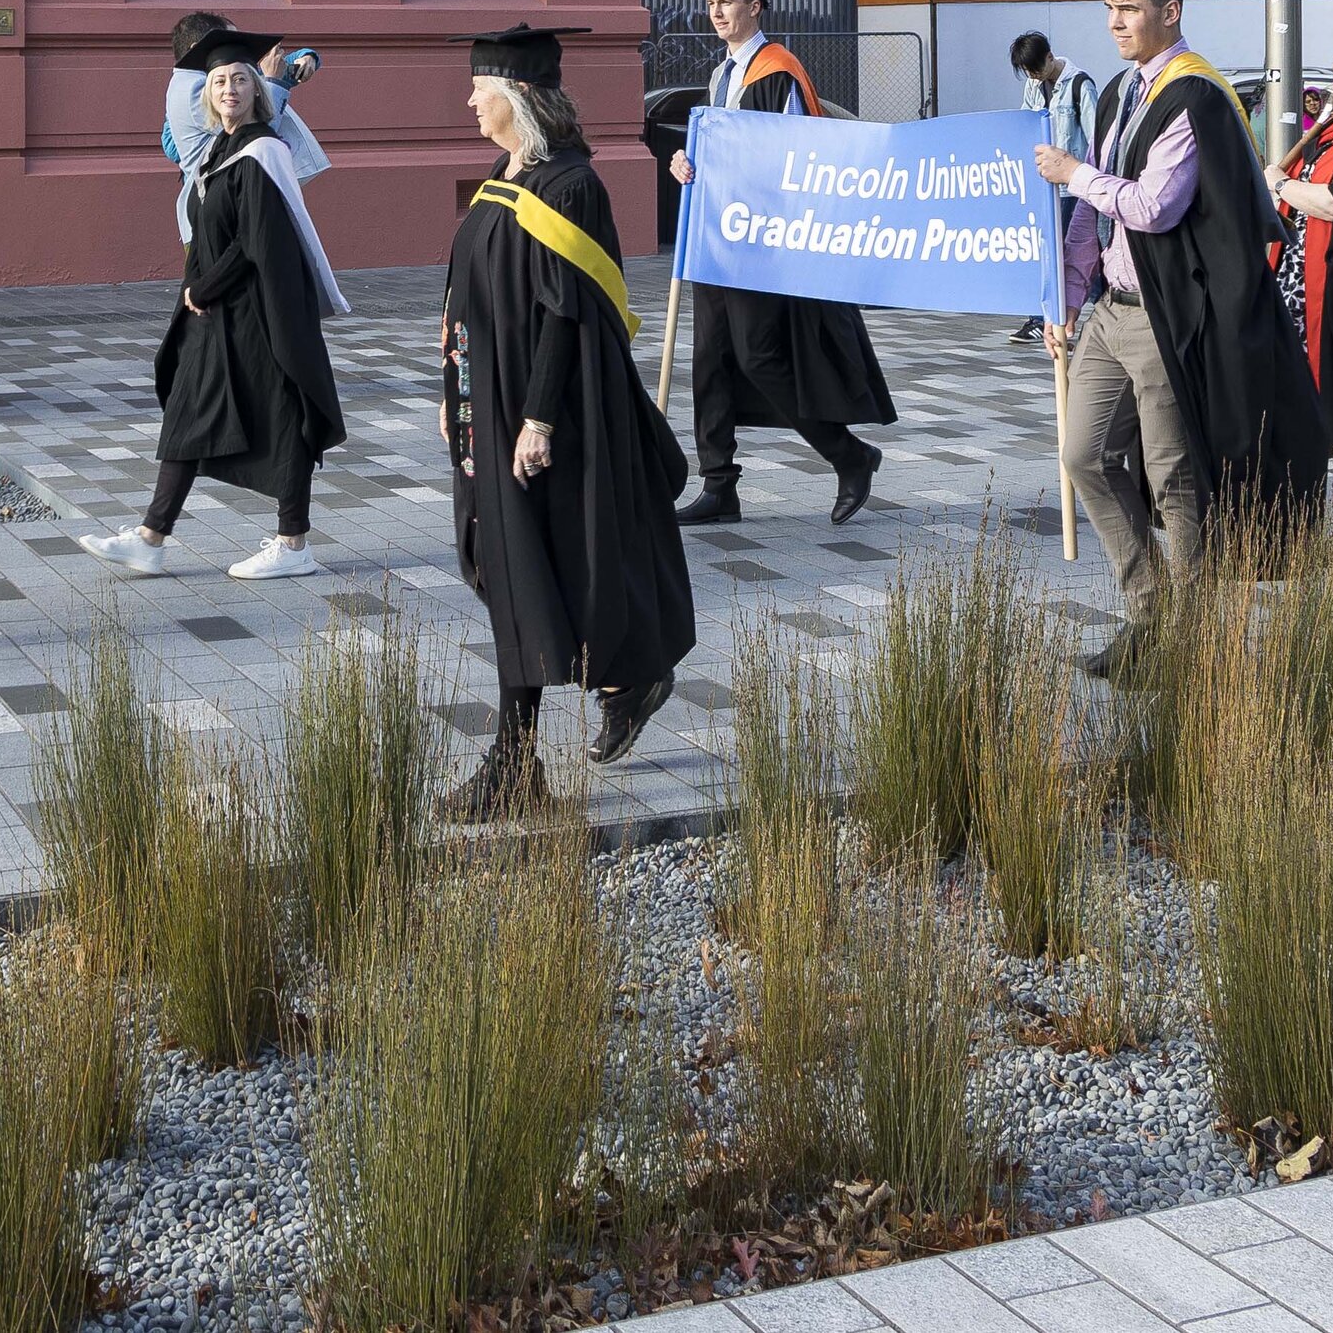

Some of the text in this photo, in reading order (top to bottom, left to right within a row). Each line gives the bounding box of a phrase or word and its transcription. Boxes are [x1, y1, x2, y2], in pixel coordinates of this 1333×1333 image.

[780, 148, 1026, 205] Lincoln University
[720, 201, 1043, 263] Graduation Processi
